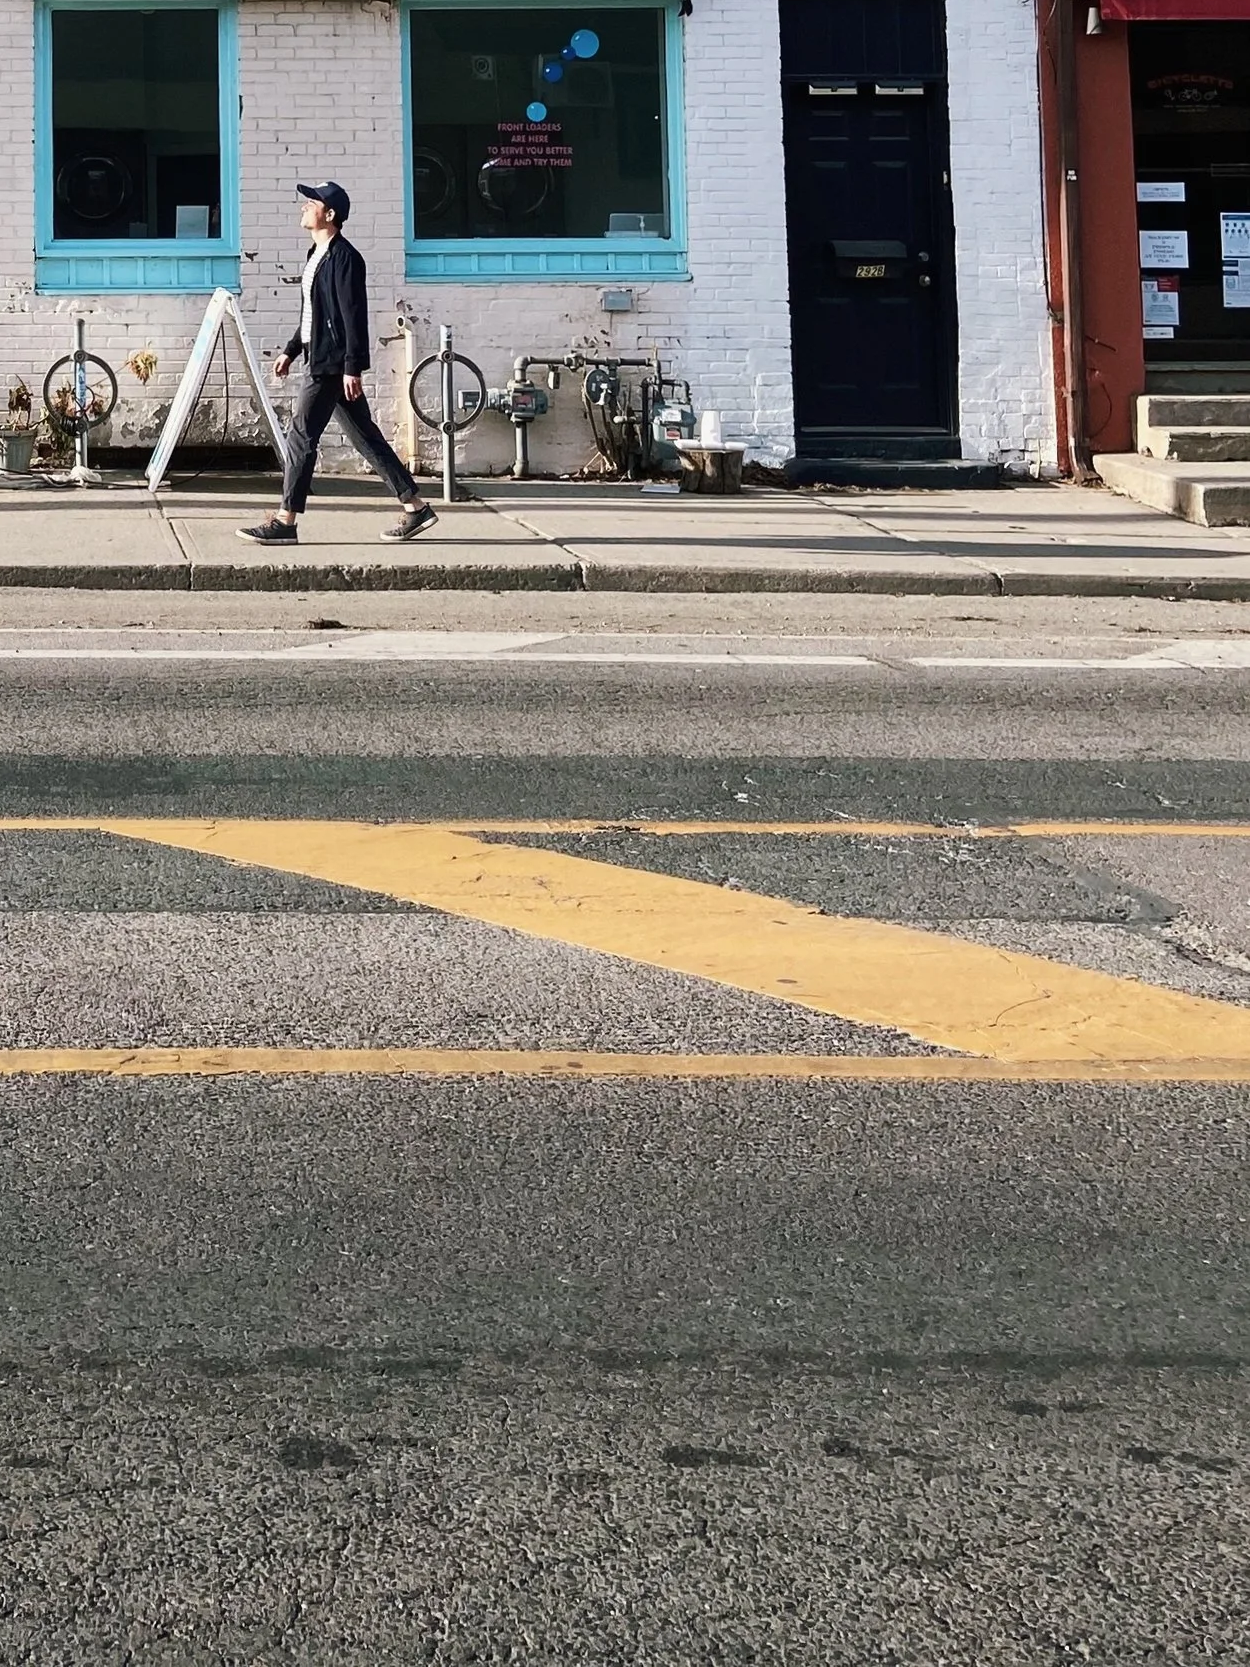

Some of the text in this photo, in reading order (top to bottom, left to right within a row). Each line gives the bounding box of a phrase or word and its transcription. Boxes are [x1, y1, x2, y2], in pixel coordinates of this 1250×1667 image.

[498, 123, 562, 131] FRONT LOADERS
[490, 158, 572, 166] OME AND TRY THEM
[857, 266, 884, 277] 292B
